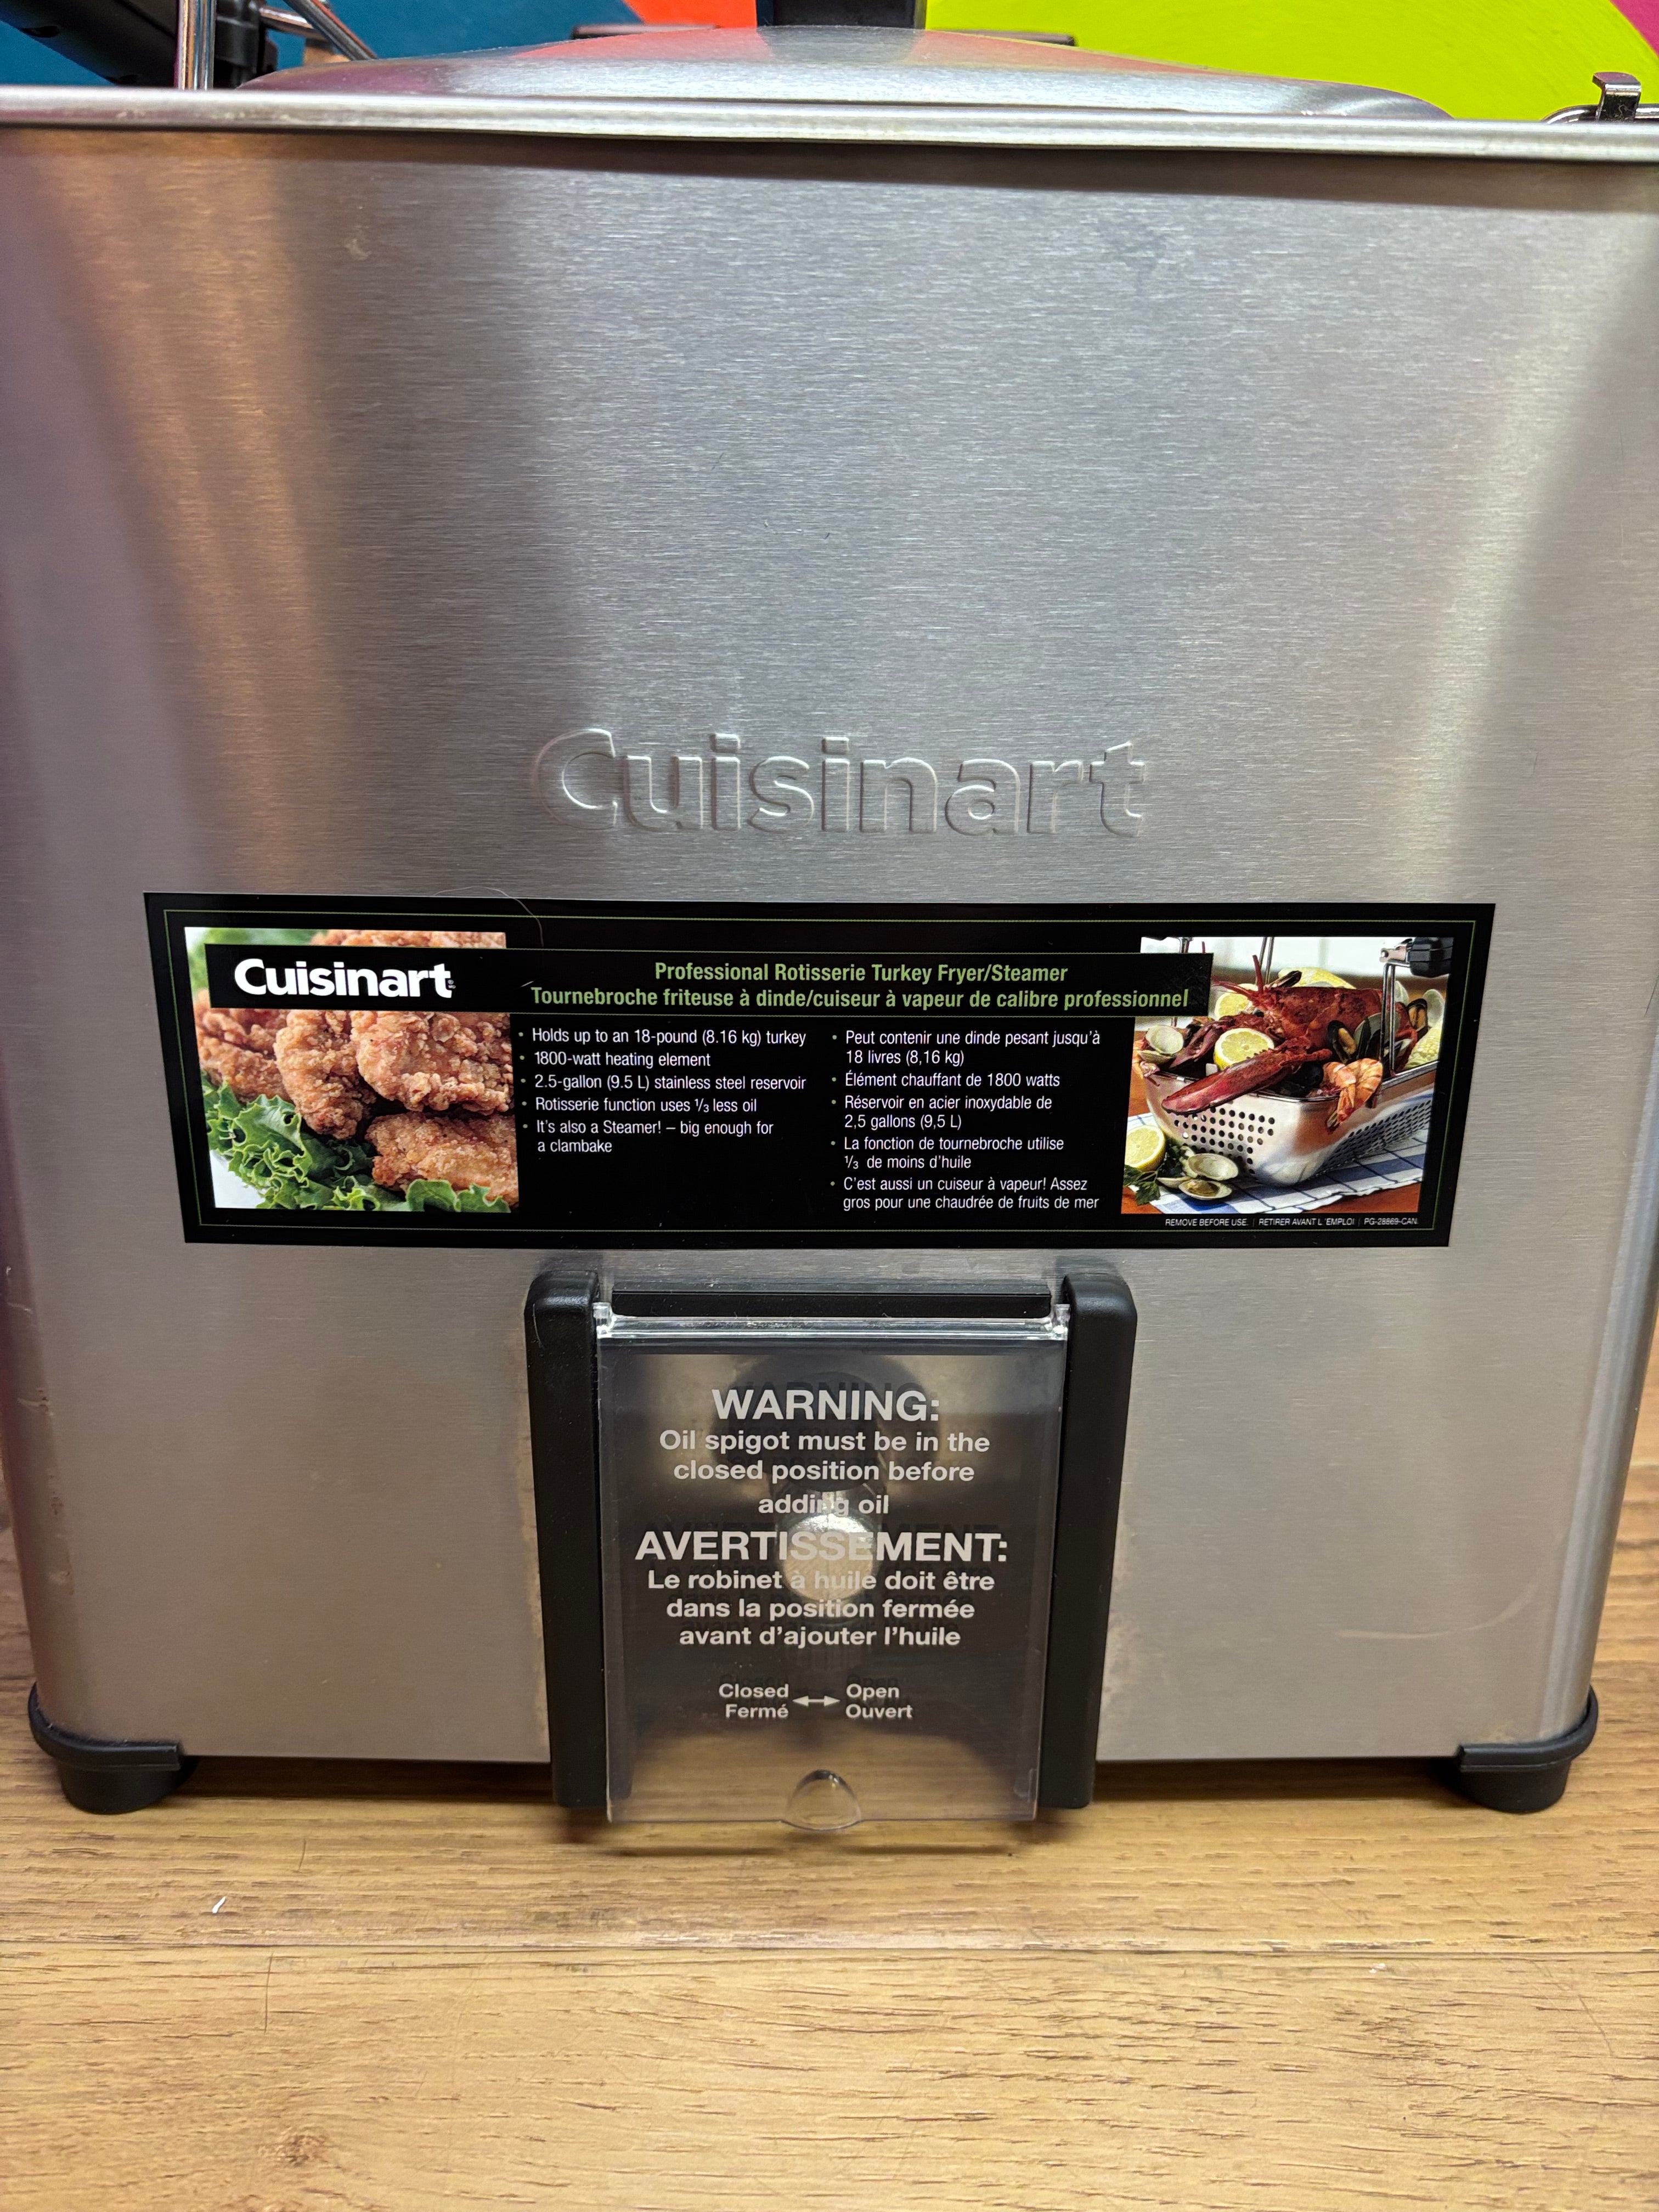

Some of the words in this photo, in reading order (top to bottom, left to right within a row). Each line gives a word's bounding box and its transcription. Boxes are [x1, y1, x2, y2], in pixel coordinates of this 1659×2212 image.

[533, 727, 1146, 837] Cuisinart
[234, 958, 453, 998] Cuisinart
[655, 962, 768, 980] Professional
[775, 963, 866, 981] Rotisserie
[871, 964, 932, 985] Turkey
[938, 964, 1068, 985] Fryer/Steamer
[531, 987, 658, 1006] Tournebroche
[663, 988, 733, 1006] friteuse
[740, 989, 750, 1007] à
[756, 989, 881, 1007] dinde/cuiseur
[885, 989, 896, 1007] à
[902, 994, 964, 1011] vapeur
[969, 990, 991, 1007] de
[996, 990, 1058, 1007] calibre
[1064, 989, 1188, 1011] professionnel
[532, 1028, 569, 1042] Holds
[574, 1031, 591, 1045] up
[595, 1029, 608, 1043] to
[612, 1031, 629, 1043] an
[634, 1029, 697, 1046] 18-pound
[702, 1029, 737, 1046] (8.16
[742, 1030, 761, 1047] kg)
[766, 1030, 806, 1047] turkey
[846, 1030, 876, 1045] Peut
[879, 1030, 932, 1045] contenir
[936, 1033, 961, 1045] une
[965, 1030, 1001, 1045] dinde
[1005, 1031, 1049, 1047] pesant
[1052, 1030, 1100, 1048] jusqu’à
[534, 1051, 601, 1065] 1800-watt
[605, 1052, 653, 1069] heating
[658, 1052, 711, 1066] element
[846, 1049, 863, 1064] 18
[868, 1049, 901, 1064] livres
[906, 1049, 940, 1066] (8,16
[945, 1050, 964, 1067] kg)
[534, 1074, 602, 1091] 2.5-gallon
[607, 1075, 633, 1091] (9.5
[637, 1075, 650, 1092] L)
[654, 1075, 711, 1090] stainless
[715, 1076, 746, 1090] steel
[751, 1076, 806, 1090] reservoir
[845, 1069, 897, 1087] Élément
[901, 1073, 962, 1087] chauffant
[966, 1073, 982, 1087] de
[987, 1073, 1021, 1087] 1800
[1025, 1073, 1060, 1087] watts
[535, 1097, 599, 1111] Rotisserie
[603, 1097, 656, 1111] function
[661, 1101, 691, 1112] uses
[713, 1098, 738, 1112] less
[742, 1098, 757, 1112] oil
[845, 1094, 905, 1109] Réservoir
[909, 1098, 924, 1109] en
[929, 1095, 961, 1109] acier
[965, 1095, 1032, 1112] inoxydable
[1036, 1095, 1052, 1109] de
[537, 1119, 555, 1133] It’s
[560, 1120, 586, 1133] also
[590, 1122, 599, 1134] a
[603, 1120, 661, 1134] Steamer!
[680, 1120, 699, 1137] big
[704, 1121, 752, 1137] enough
[756, 1120, 774, 1135] for
[844, 1114, 866, 1129] 2,5
[871, 1114, 916, 1131] gallons
[920, 1114, 945, 1130] (9,5
[950, 1114, 962, 1131] L)
[538, 1141, 546, 1152] a
[550, 1139, 612, 1153] clambake
[844, 1136, 860, 1150] La
[864, 1136, 914, 1150] fonction
[918, 1136, 934, 1150] de
[939, 1136, 1023, 1150] tournebroche
[1027, 1136, 1064, 1150] utilise
[867, 1155, 882, 1169] de
[887, 1155, 925, 1169] moins
[929, 1155, 972, 1169] d’huile
[844, 1176, 876, 1190] C’est
[880, 1177, 912, 1190] aussi
[917, 1180, 933, 1190] un
[938, 1176, 984, 1190] cuiseur
[988, 1176, 995, 1190] à
[1000, 1177, 1046, 1193] vapeur!
[1050, 1177, 1087, 1190] Assez
[843, 1198, 871, 1211] gros
[875, 1198, 904, 1211] pour
[908, 1198, 931, 1209] une
[935, 1195, 994, 1209] chaudrée
[998, 1195, 1013, 1209] de
[1018, 1195, 1049, 1209] fruits
[1054, 1195, 1070, 1209] de
[1074, 1198, 1099, 1209] mer
[1165, 1218, 1198, 1227] REMOVE
[1259, 1218, 1290, 1226] RETIRER
[711, 1387, 941, 1421] WARNING:
[659, 1430, 696, 1450] Oil
[702, 1430, 790, 1455] spigot
[798, 1432, 866, 1451] must
[874, 1431, 907, 1451] be
[916, 1431, 938, 1451] in
[946, 1432, 990, 1452] the
[674, 1459, 763, 1480] closed
[772, 1460, 879, 1484] position
[889, 1461, 974, 1481] before
[859, 1494, 888, 1514] oil
[635, 1531, 1007, 1561] AVERTISSEMENT:
[648, 1570, 680, 1589] Le
[689, 1570, 782, 1589] robinet
[791, 1570, 806, 1590] à
[814, 1572, 876, 1590] huile
[885, 1571, 936, 1590] doit
[943, 1571, 995, 1590] être
[667, 1598, 730, 1617] dans
[739, 1598, 760, 1617] la
[770, 1597, 874, 1621] position
[882, 1599, 975, 1618] fermée
[679, 1627, 752, 1645] avant
[759, 1626, 877, 1649] d’ajouter
[884, 1627, 961, 1645] l’huile
[719, 1683, 789, 1698] Closed
[846, 1683, 899, 1701] Open
[725, 1703, 789, 1718] Fermé
[845, 1703, 913, 1718] Ouvert
